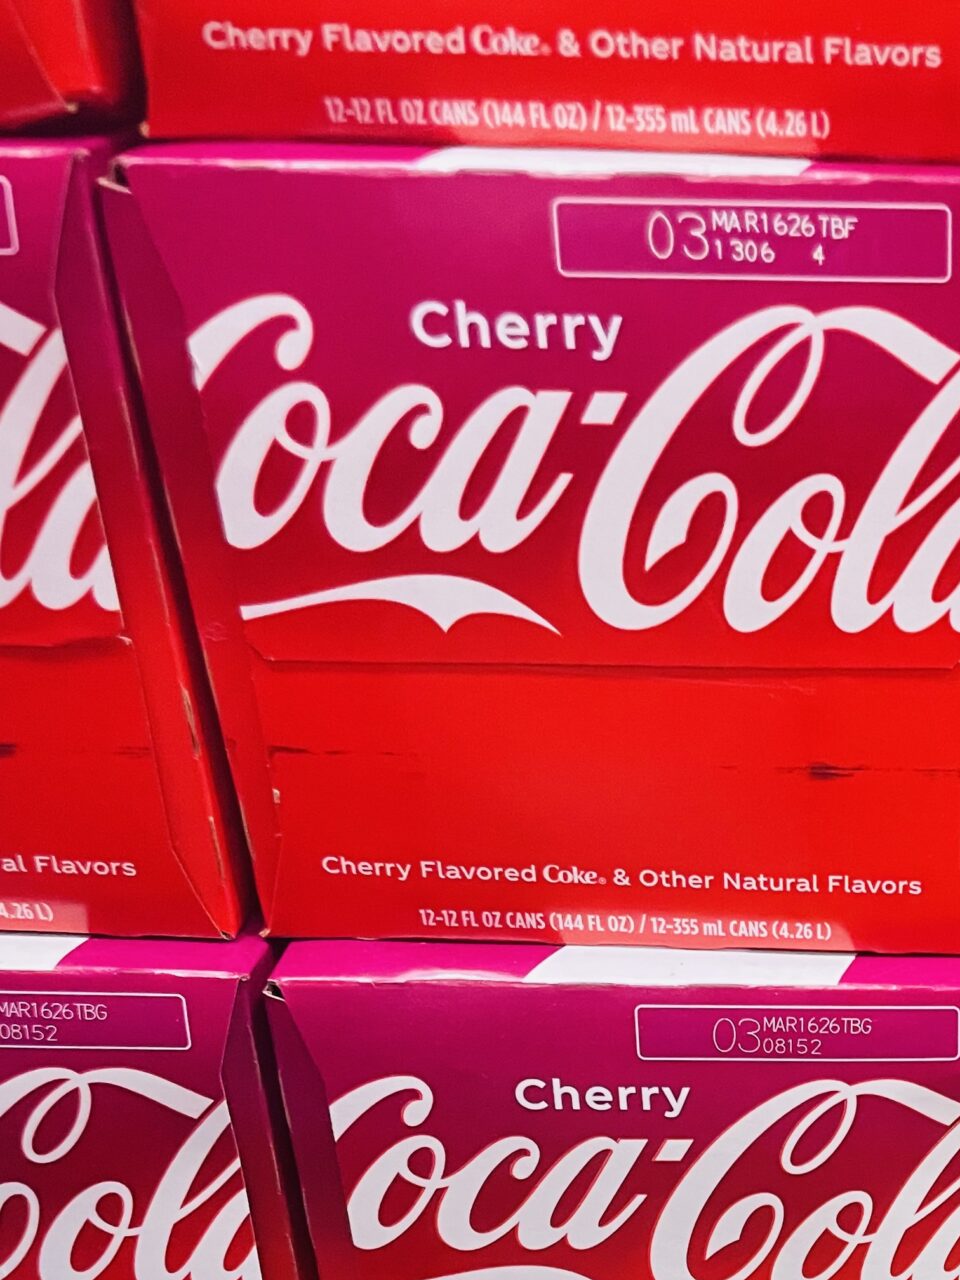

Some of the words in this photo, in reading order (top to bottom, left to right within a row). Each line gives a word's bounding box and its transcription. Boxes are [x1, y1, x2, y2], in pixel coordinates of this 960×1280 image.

[202, 20, 313, 58] Cherry
[321, 23, 466, 54] Flavored
[557, 29, 581, 57] &
[590, 31, 684, 61] Other
[694, 33, 814, 65] Natural
[823, 37, 942, 69] Flavors
[324, 96, 373, 125] 12-12
[378, 97, 398, 125] FL
[401, 98, 428, 126] OZ
[430, 99, 479, 127] CANS
[482, 99, 526, 129] (144
[529, 100, 549, 129] FL
[553, 102, 587, 131] OZ)
[606, 104, 666, 133] 12-355
[704, 107, 751, 136] CANS
[756, 108, 808, 139] (4.26
[811, 110, 830, 140] L)
[648, 210, 709, 261] 03
[813, 244, 826, 266] 4
[409, 299, 624, 361] Cherry
[34, 855, 137, 877] Flavors
[322, 855, 411, 881] Cherry
[420, 860, 537, 883] Flavored
[612, 868, 631, 886] &
[639, 868, 714, 890] Other
[723, 872, 819, 893] Natural
[828, 875, 922, 896] Flavors
[0, 902, 35, 920] 4.26
[34, 902, 54, 922] L)
[418, 908, 459, 928] 12-12
[461, 909, 479, 928] FL
[482, 910, 503, 929] OZ
[505, 911, 545, 930] CANS
[549, 912, 584, 932] (144
[588, 913, 605, 932] FL
[607, 913, 635, 934] OZ)
[650, 916, 699, 936] 12-355
[729, 919, 767, 938] CANS
[771, 920, 813, 941] (4.26
[816, 921, 832, 942] L)
[713, 1017, 761, 1053] 03
[763, 1038, 822, 1055] 08152
[514, 1077, 691, 1118] Cherry
